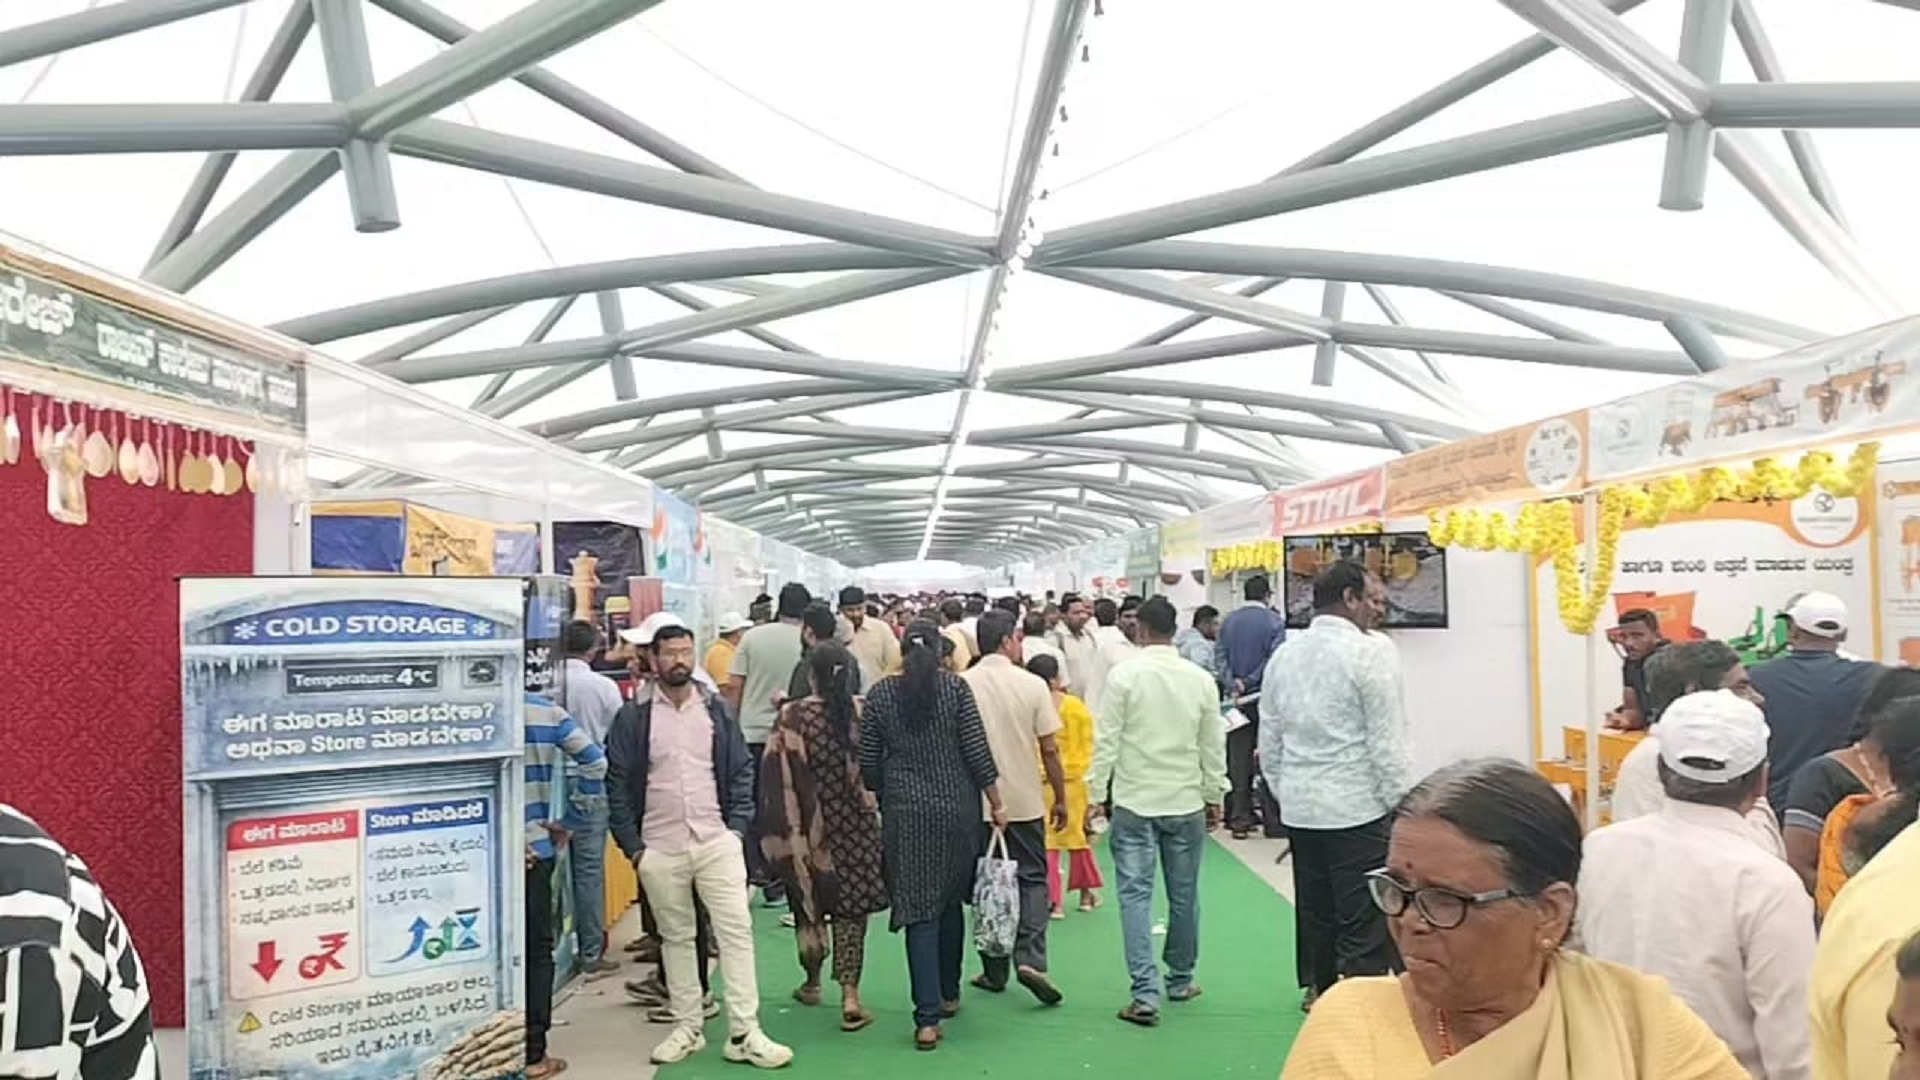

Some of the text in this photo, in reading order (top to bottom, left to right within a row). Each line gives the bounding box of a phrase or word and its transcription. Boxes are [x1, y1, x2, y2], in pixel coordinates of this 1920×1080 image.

[1283, 484, 1371, 529] STIHL
[265, 615, 468, 637] COLD STORAGE
[222, 703, 495, 734] ಈಗ ಮಾರಾಟ ಮಾಡಬೇಕಾ?
[226, 725, 495, 760] ಅಥವಾ Store ಮಾಡಬೇಕಾ?
[242, 817, 347, 842] ಈಗ ಮಾರಾಟ
[370, 801, 484, 829] Store ಮಾಡಿದರೆ
[240, 855, 303, 876] ಬೆಲೆ ಕಡಿಮೆ
[269, 1009, 303, 1026] Cold
[307, 999, 363, 1020] Storage
[367, 981, 460, 1008] ಮಾಯಾಜಾಲ
[269, 1022, 342, 1050] ಸರಿಯಾದ
[347, 1007, 432, 1036] ಸಮಯದಲ್ಲಿ
[315, 1046, 350, 1065] ಇದು
[355, 1031, 411, 1058] ರೈತನಿಗೆ
